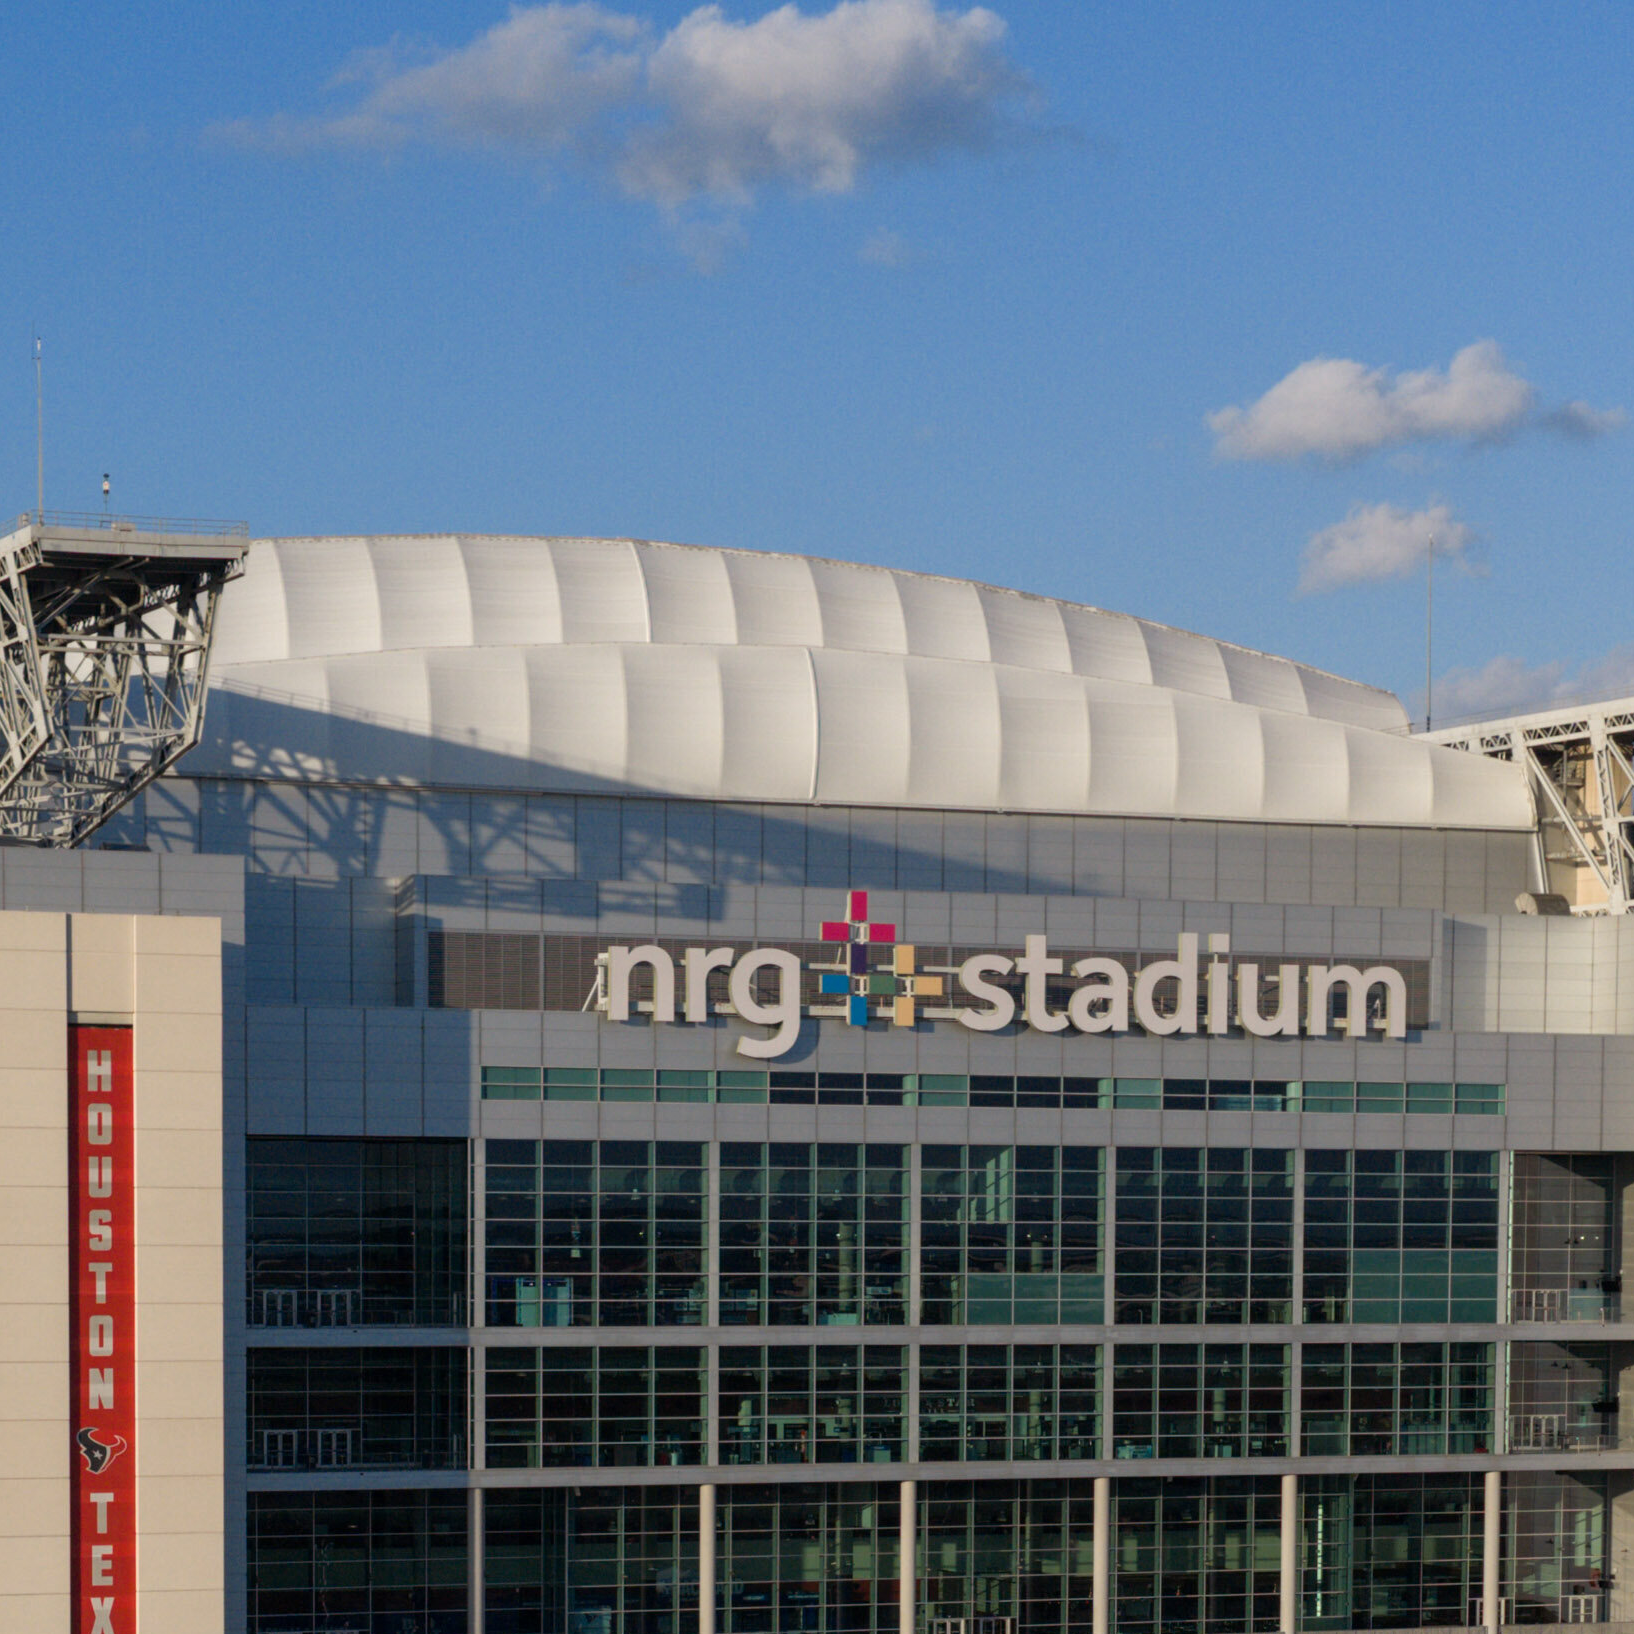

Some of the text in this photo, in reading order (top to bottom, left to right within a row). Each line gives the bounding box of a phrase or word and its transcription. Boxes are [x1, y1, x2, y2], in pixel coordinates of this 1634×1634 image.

[605, 931, 1406, 1058] nrg stadium
[87, 1050, 115, 1410] HOUSTON
